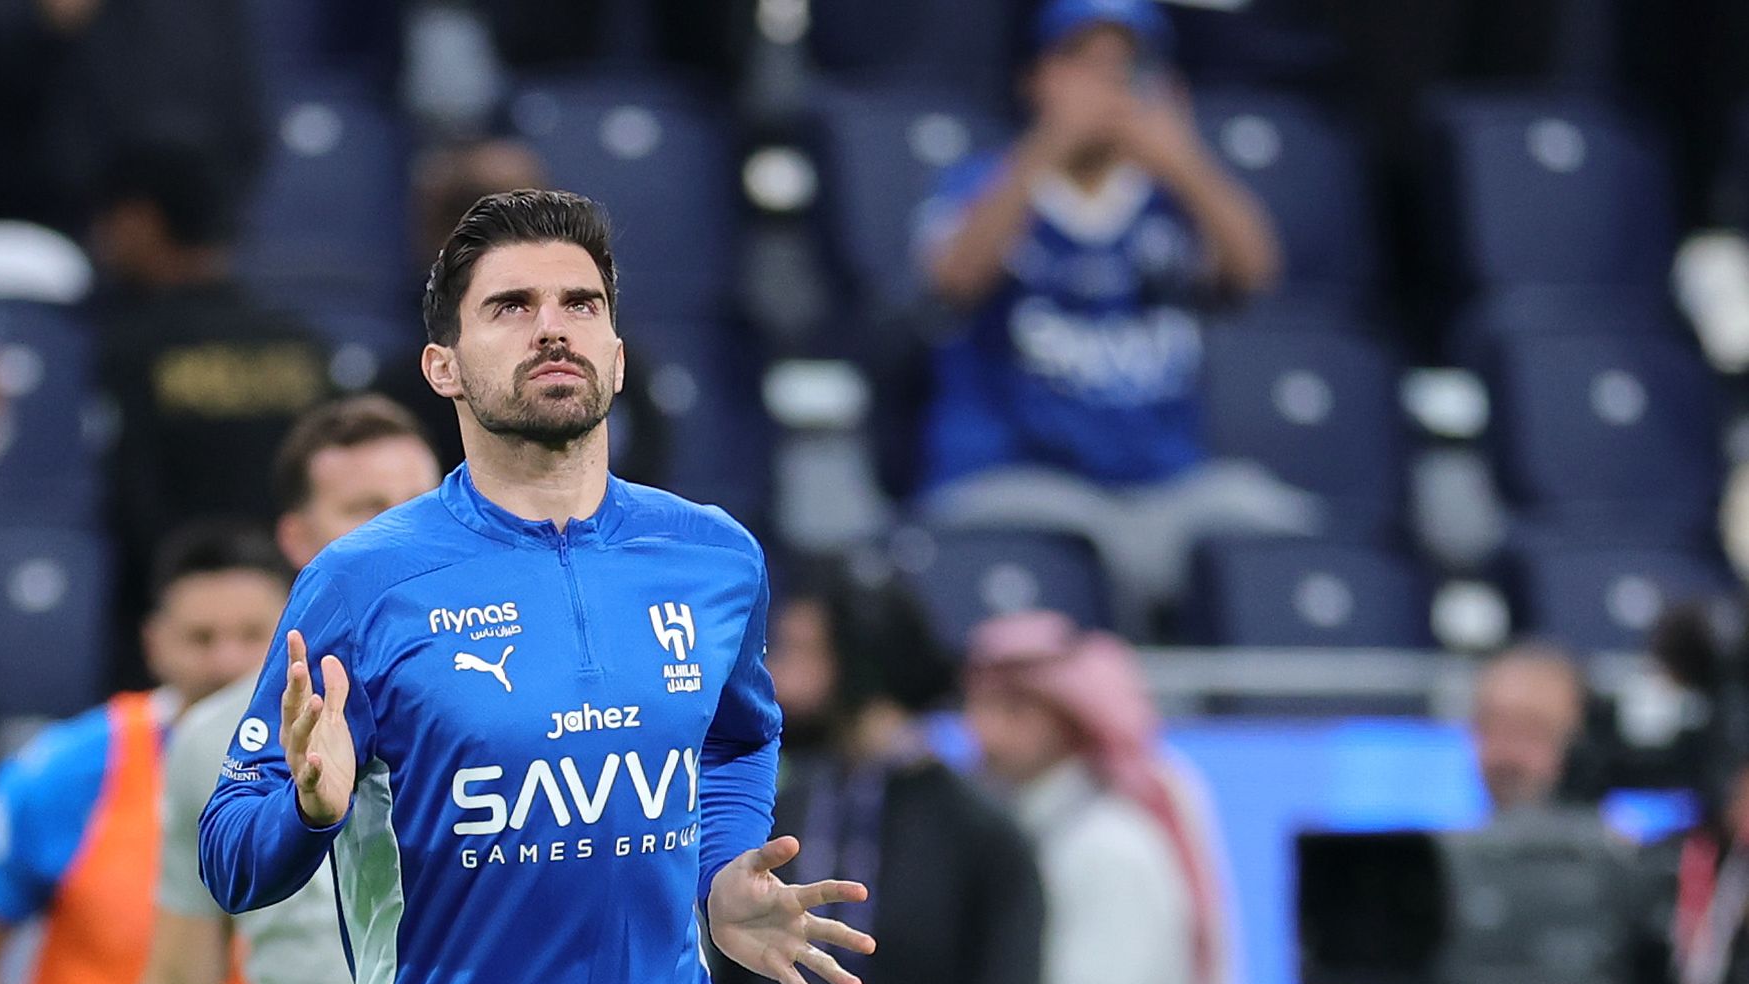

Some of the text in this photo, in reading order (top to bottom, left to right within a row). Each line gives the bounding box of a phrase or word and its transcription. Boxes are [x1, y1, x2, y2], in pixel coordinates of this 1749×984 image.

[429, 602, 519, 634] flynas
[663, 663, 702, 678] ALHILAL
[666, 677, 701, 693] الهلال
[452, 748, 700, 836] SAVVY
[461, 822, 699, 869] GAMES GROUP
